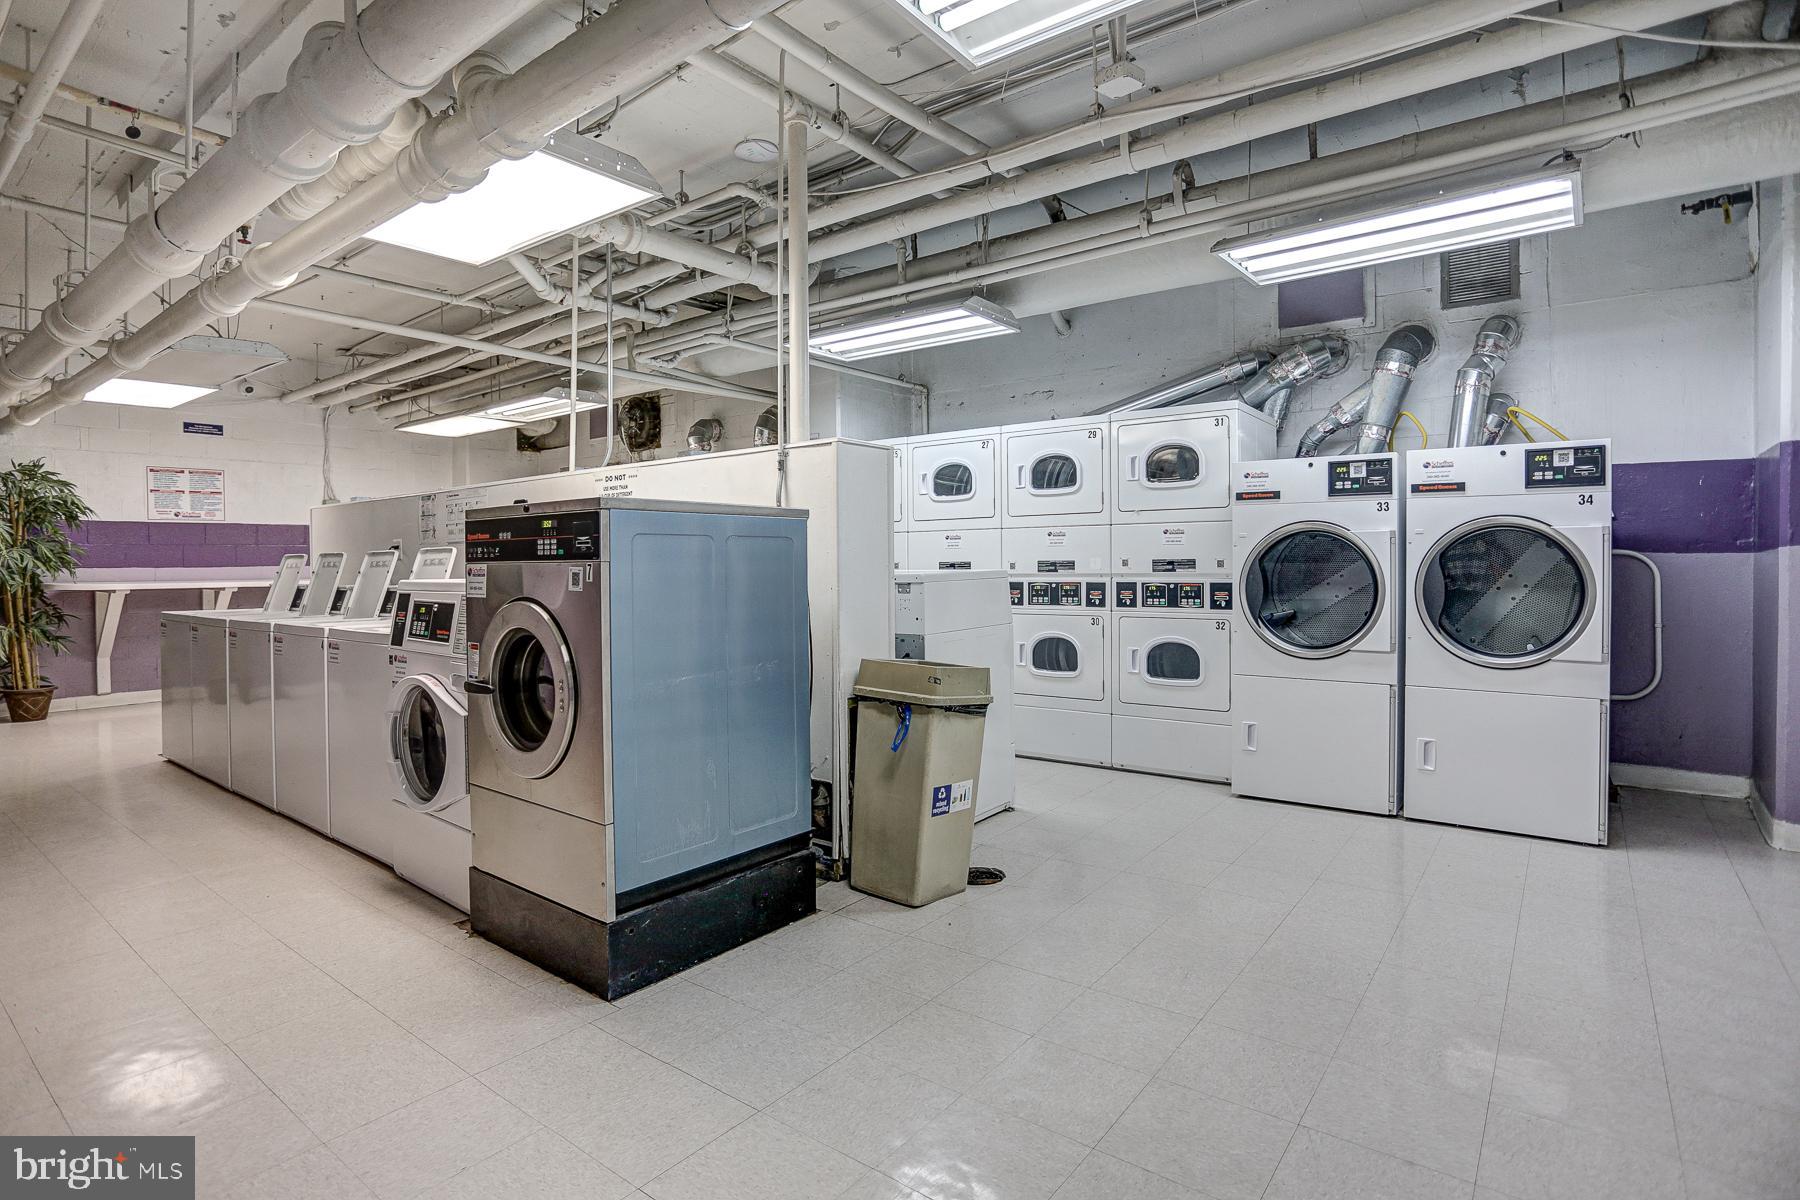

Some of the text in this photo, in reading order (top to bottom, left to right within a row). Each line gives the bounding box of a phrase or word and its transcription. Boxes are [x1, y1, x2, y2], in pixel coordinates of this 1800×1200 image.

[1214, 418, 1224, 427] 31
[1088, 430, 1097, 439] 29
[981, 441, 990, 449] 27
[614, 473, 626, 481] NOT
[1578, 494, 1593, 506] 34
[1376, 501, 1390, 512] 33
[587, 564, 592, 581] 7
[1091, 617, 1100, 626] 30
[1215, 621, 1226, 630] 32
